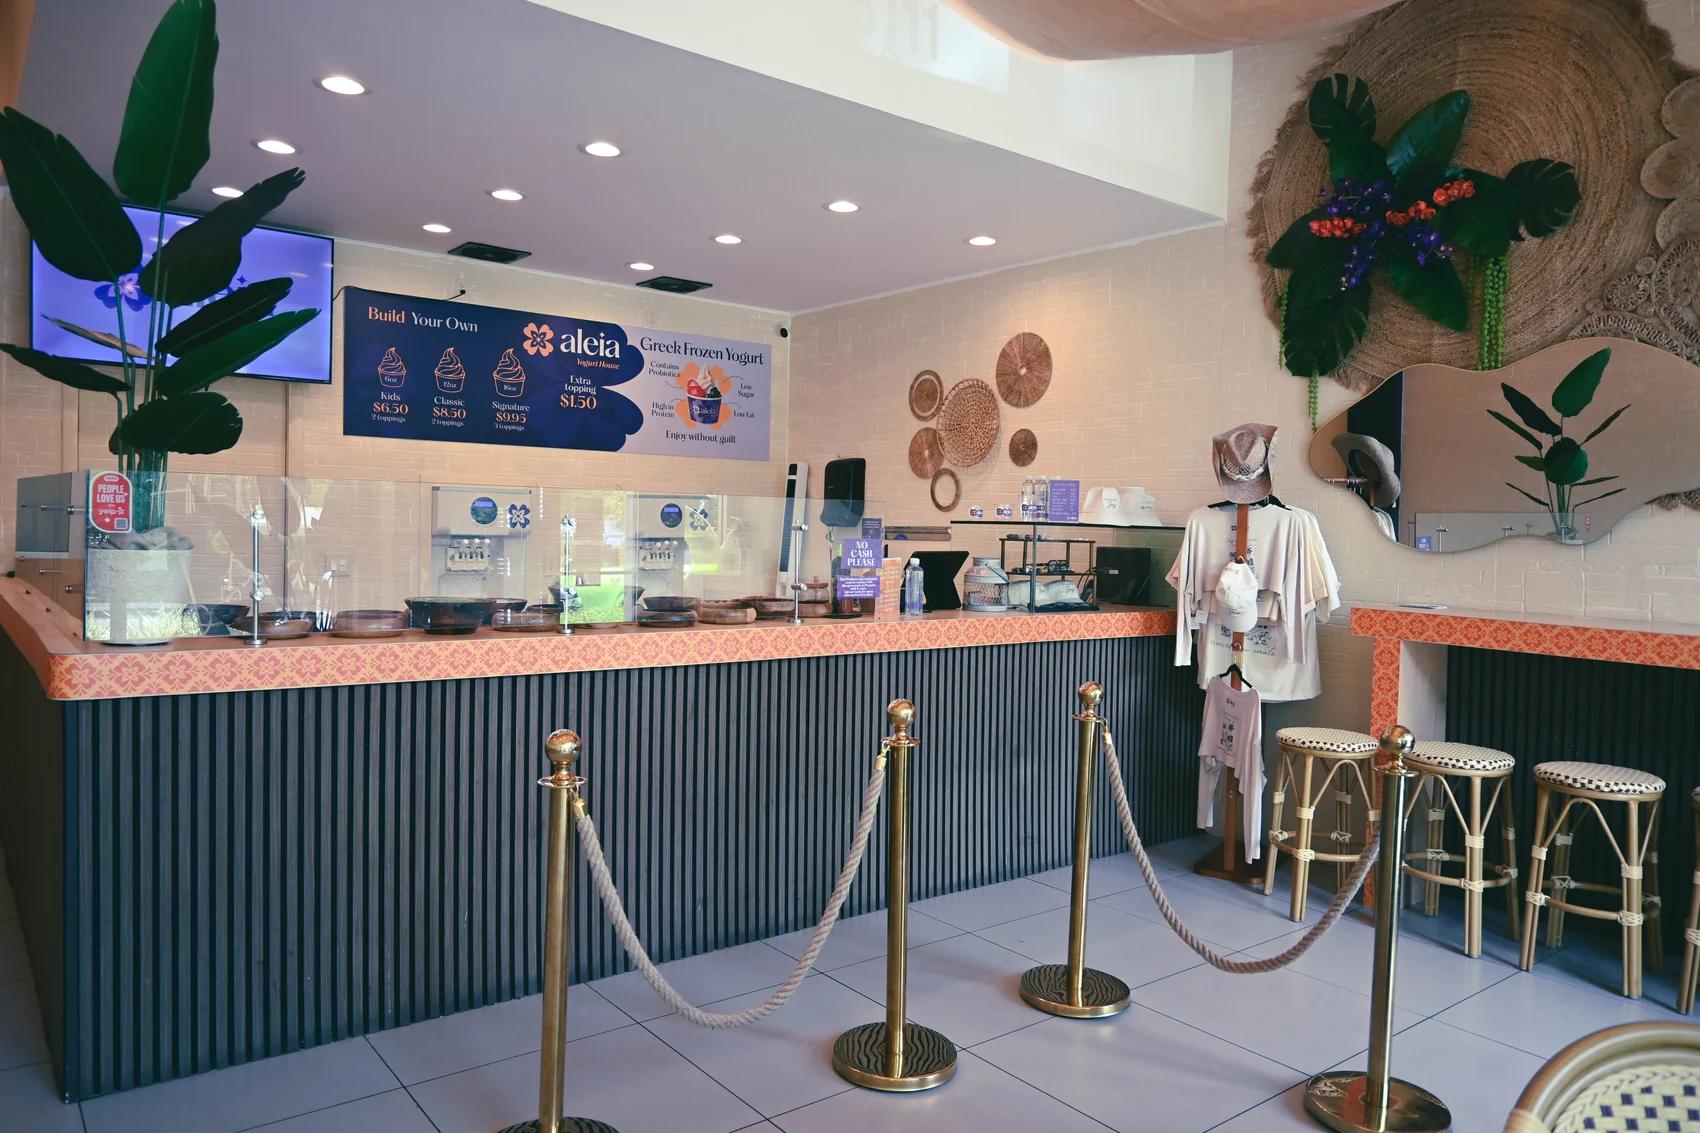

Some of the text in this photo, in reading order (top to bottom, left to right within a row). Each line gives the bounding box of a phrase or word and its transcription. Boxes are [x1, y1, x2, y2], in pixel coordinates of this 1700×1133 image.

[368, 306, 478, 332] Build Your Own
[560, 328, 620, 358] aleia
[640, 336, 763, 366] Greek Frozen Yogurt
[577, 358, 620, 370] Yogurt House
[650, 360, 680, 370] Contains
[648, 368, 681, 378] Probiotics
[384, 375, 397, 383] 6oz
[570, 375, 592, 385] Extra
[564, 383, 597, 396] topping
[740, 382, 752, 390] Low
[381, 391, 401, 401] Kids
[434, 396, 465, 407] Classic
[492, 400, 531, 412] Signature
[560, 393, 597, 410] $1.50
[652, 401, 668, 411] High
[373, 401, 409, 415] $6.50
[432, 406, 467, 419] $8.50
[377, 414, 406, 424] toppings
[495, 411, 527, 424] $9.95
[651, 409, 675, 419] Protein
[437, 418, 464, 428] toppings
[665, 429, 737, 445] Enjoy without guilt
[98, 484, 124, 493] PEOPLE
[97, 494, 126, 503] LOVE US
[856, 541, 869, 549] NO
[850, 549, 873, 557] CASH
[847, 558, 876, 566] PLEASE
